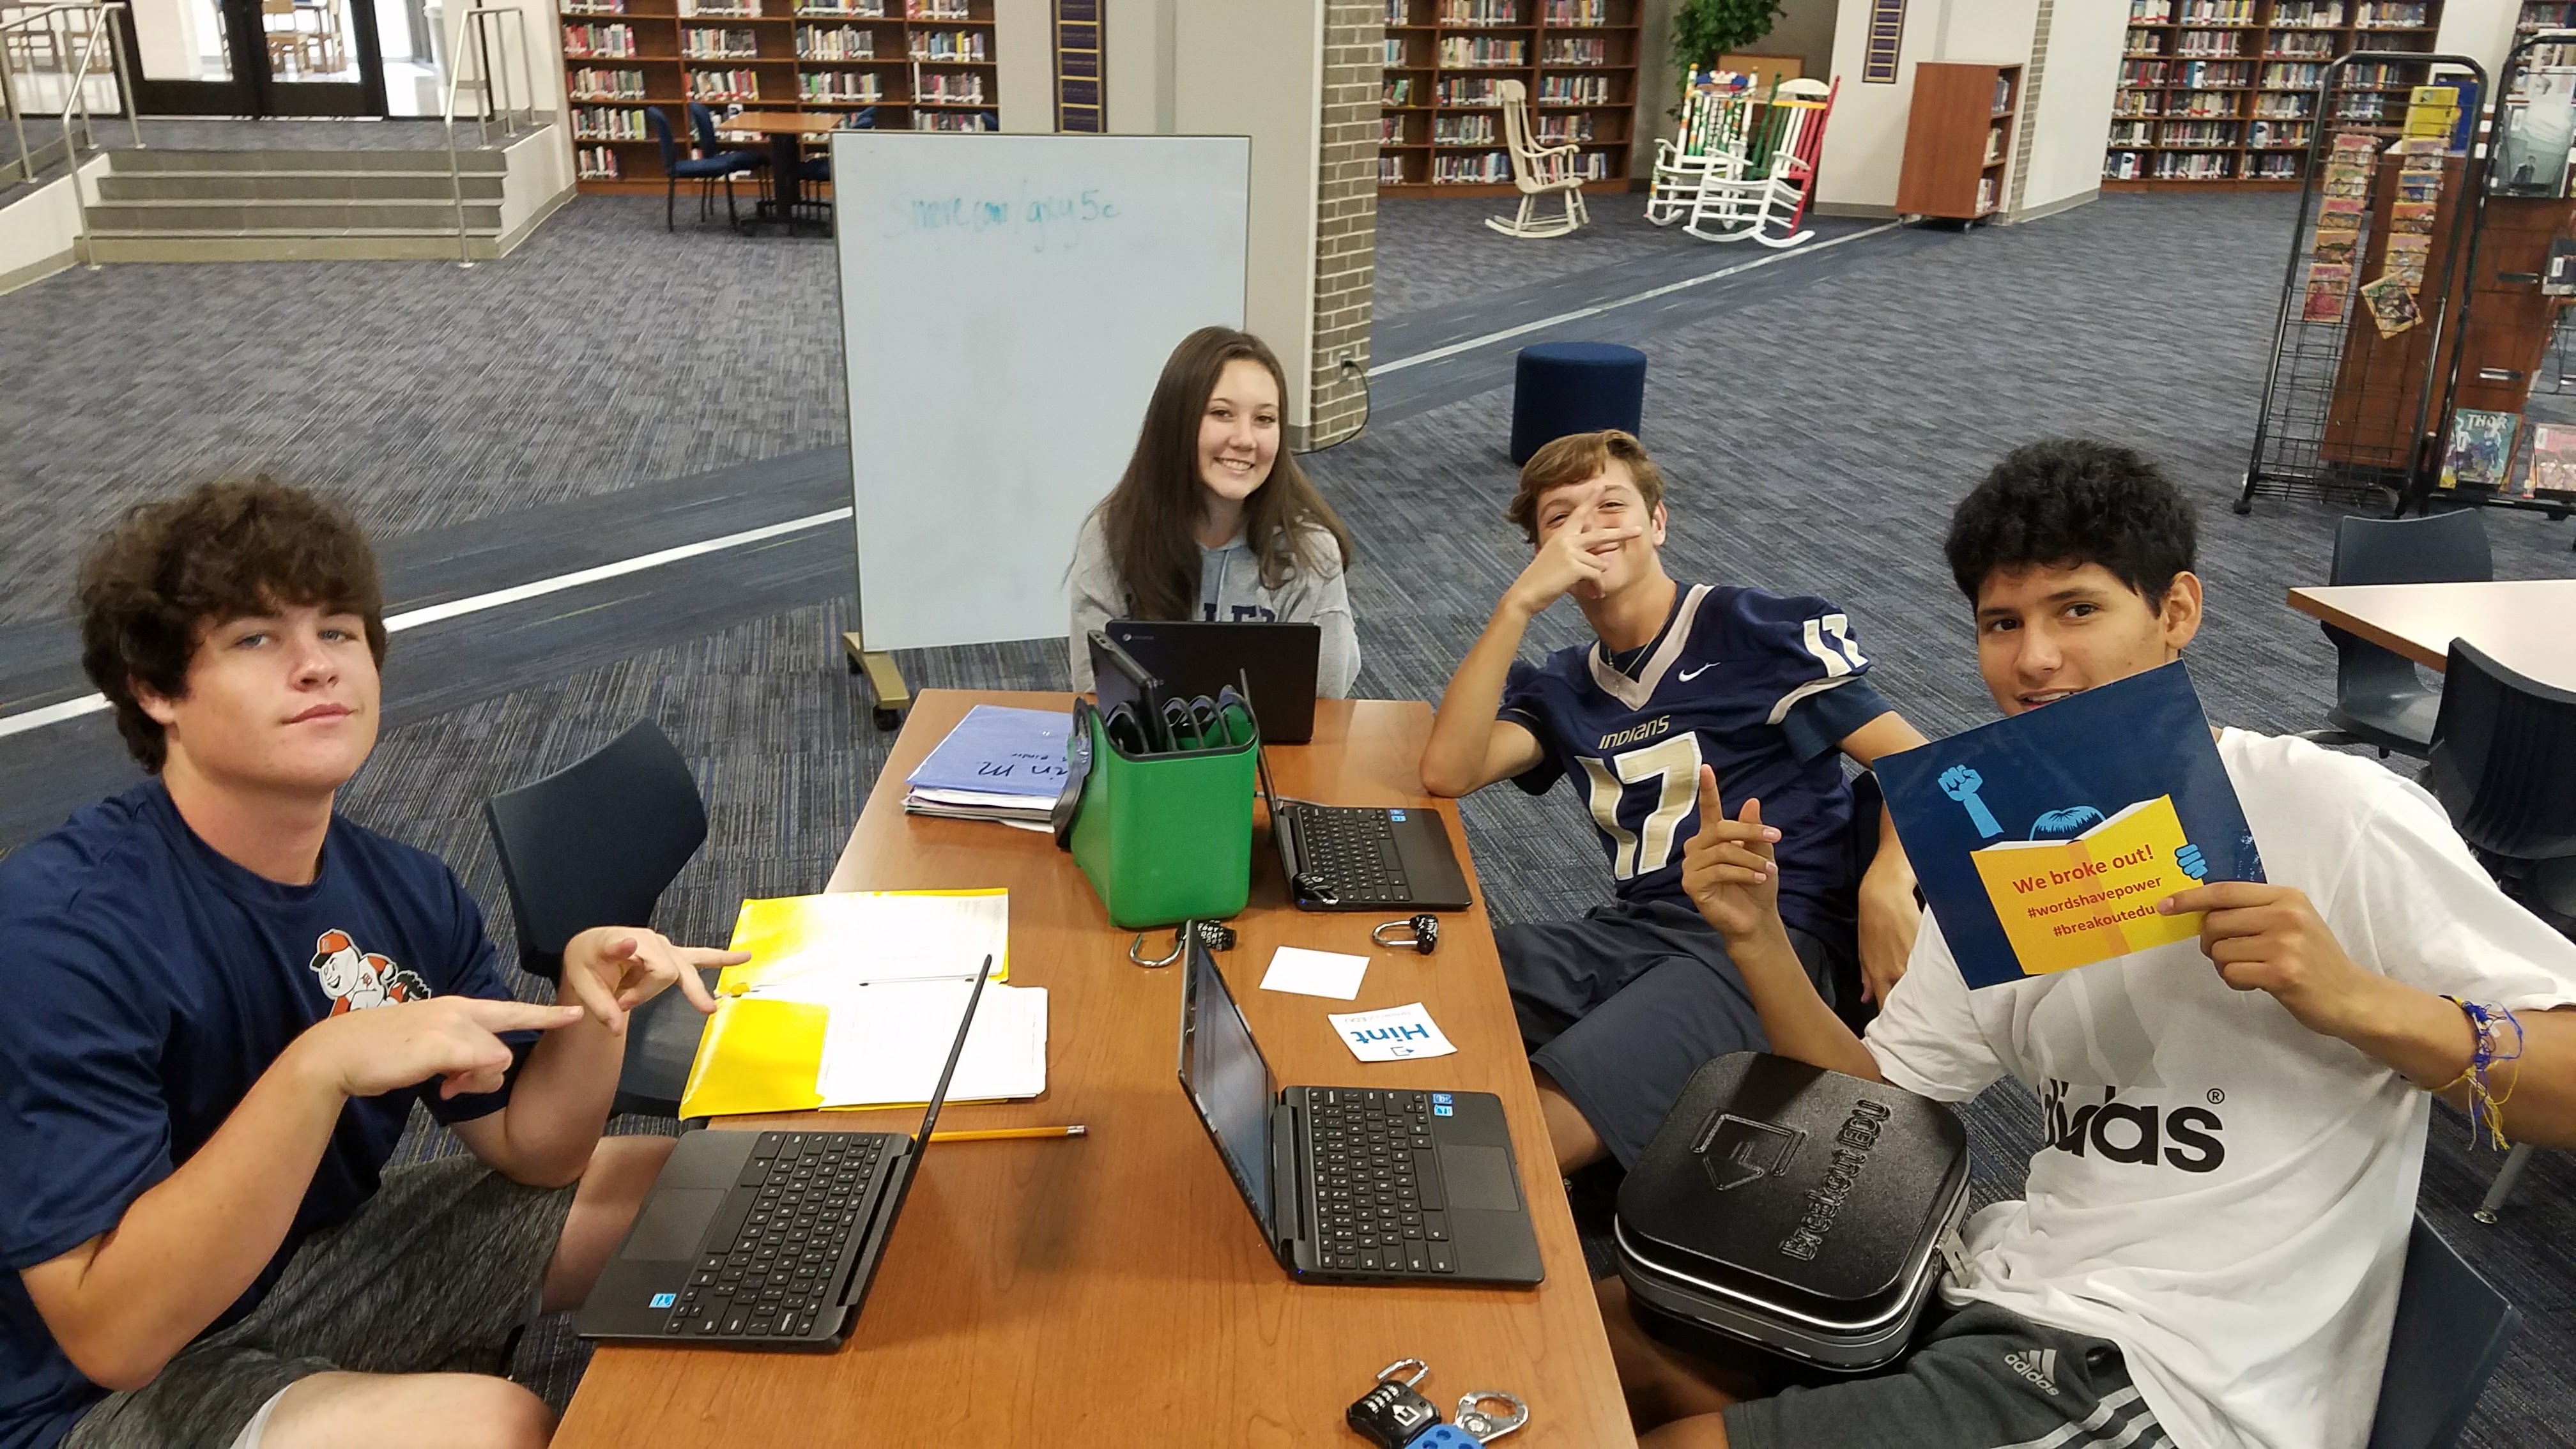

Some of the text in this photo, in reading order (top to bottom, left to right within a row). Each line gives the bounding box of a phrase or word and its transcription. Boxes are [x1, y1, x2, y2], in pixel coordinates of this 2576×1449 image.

[2467, 414, 2508, 431] THOR
[1803, 613, 1869, 678] 17
[1598, 714, 1671, 749] INDIANS
[1574, 731, 1703, 881] 17
[2012, 843, 2154, 894] We broke out!
[2027, 876, 2162, 919] #wordshavepower
[2053, 905, 2156, 937] #breakoutedu
[1350, 1023, 1430, 1045] Hint
[2005, 1354, 2060, 1396] adidas
